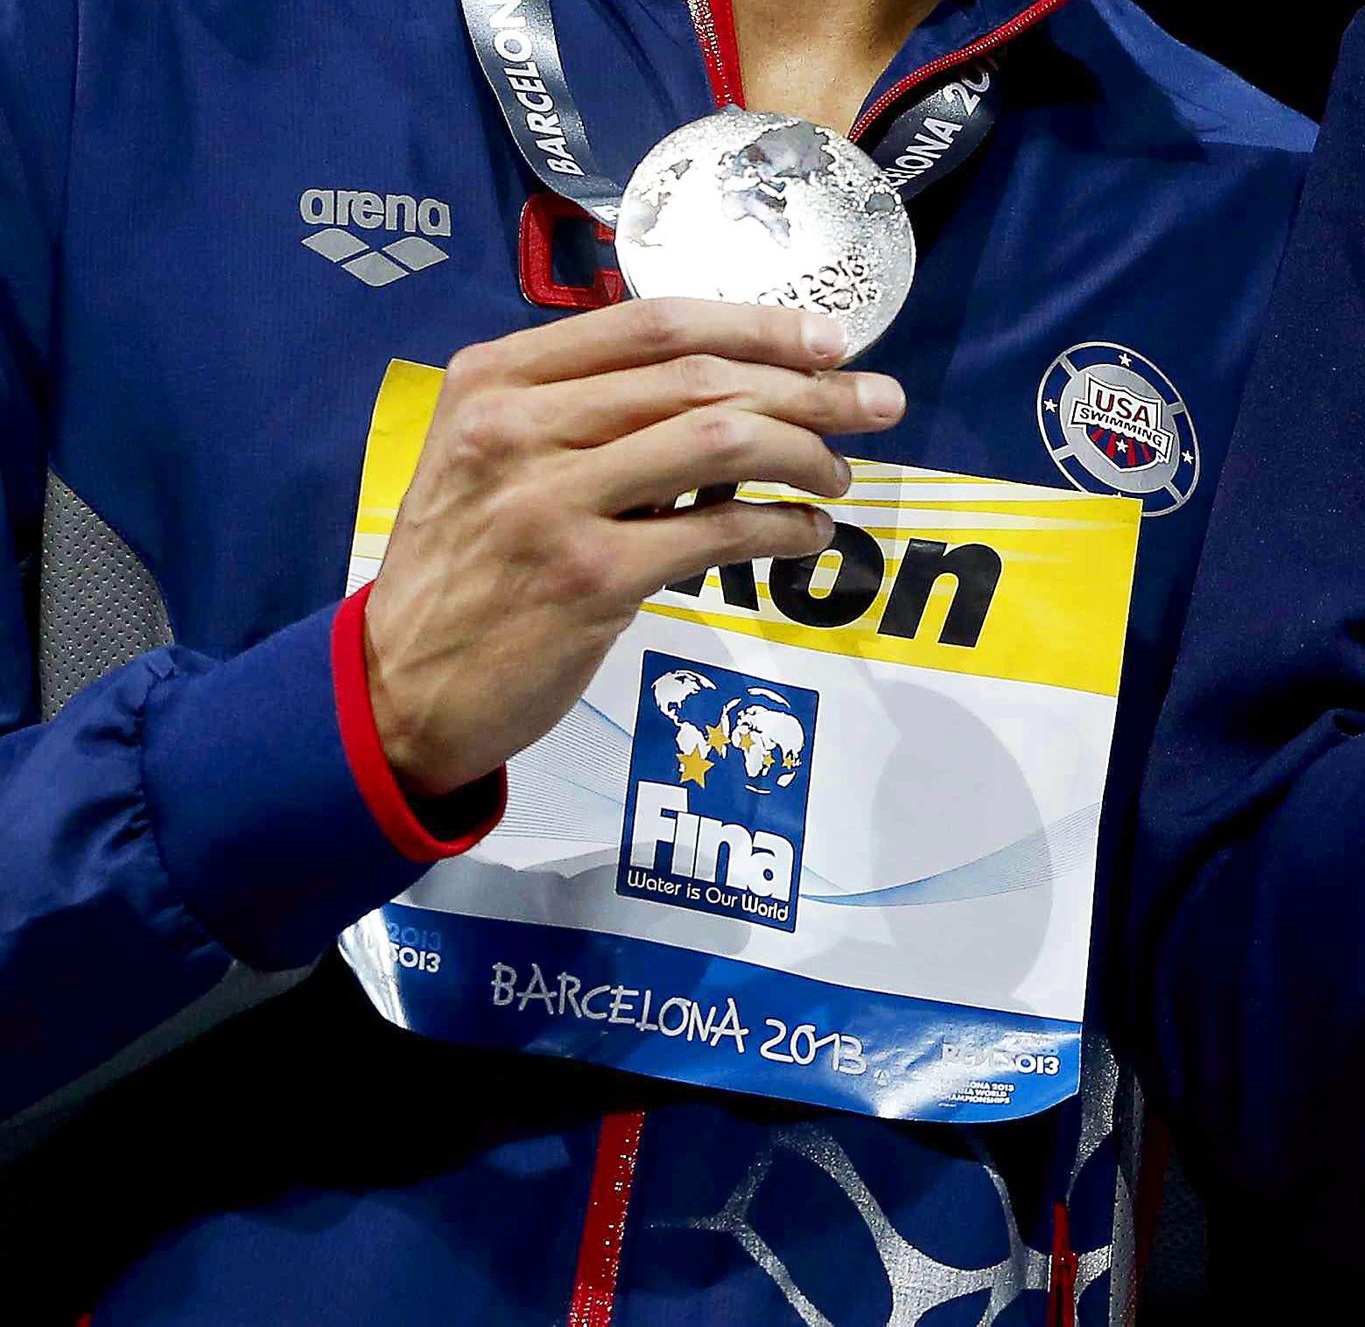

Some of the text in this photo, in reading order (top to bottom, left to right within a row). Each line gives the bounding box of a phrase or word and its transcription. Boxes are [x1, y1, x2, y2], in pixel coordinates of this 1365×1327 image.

[300, 188, 452, 237] arena
[1079, 406, 1164, 448] SWIMMING
[1095, 389, 1151, 428] USA
[629, 780, 796, 903] Fina
[626, 869, 682, 896] Water
[705, 886, 738, 908] Our
[741, 893, 790, 922] World
[490, 961, 868, 1075] BARCELONA 2013
